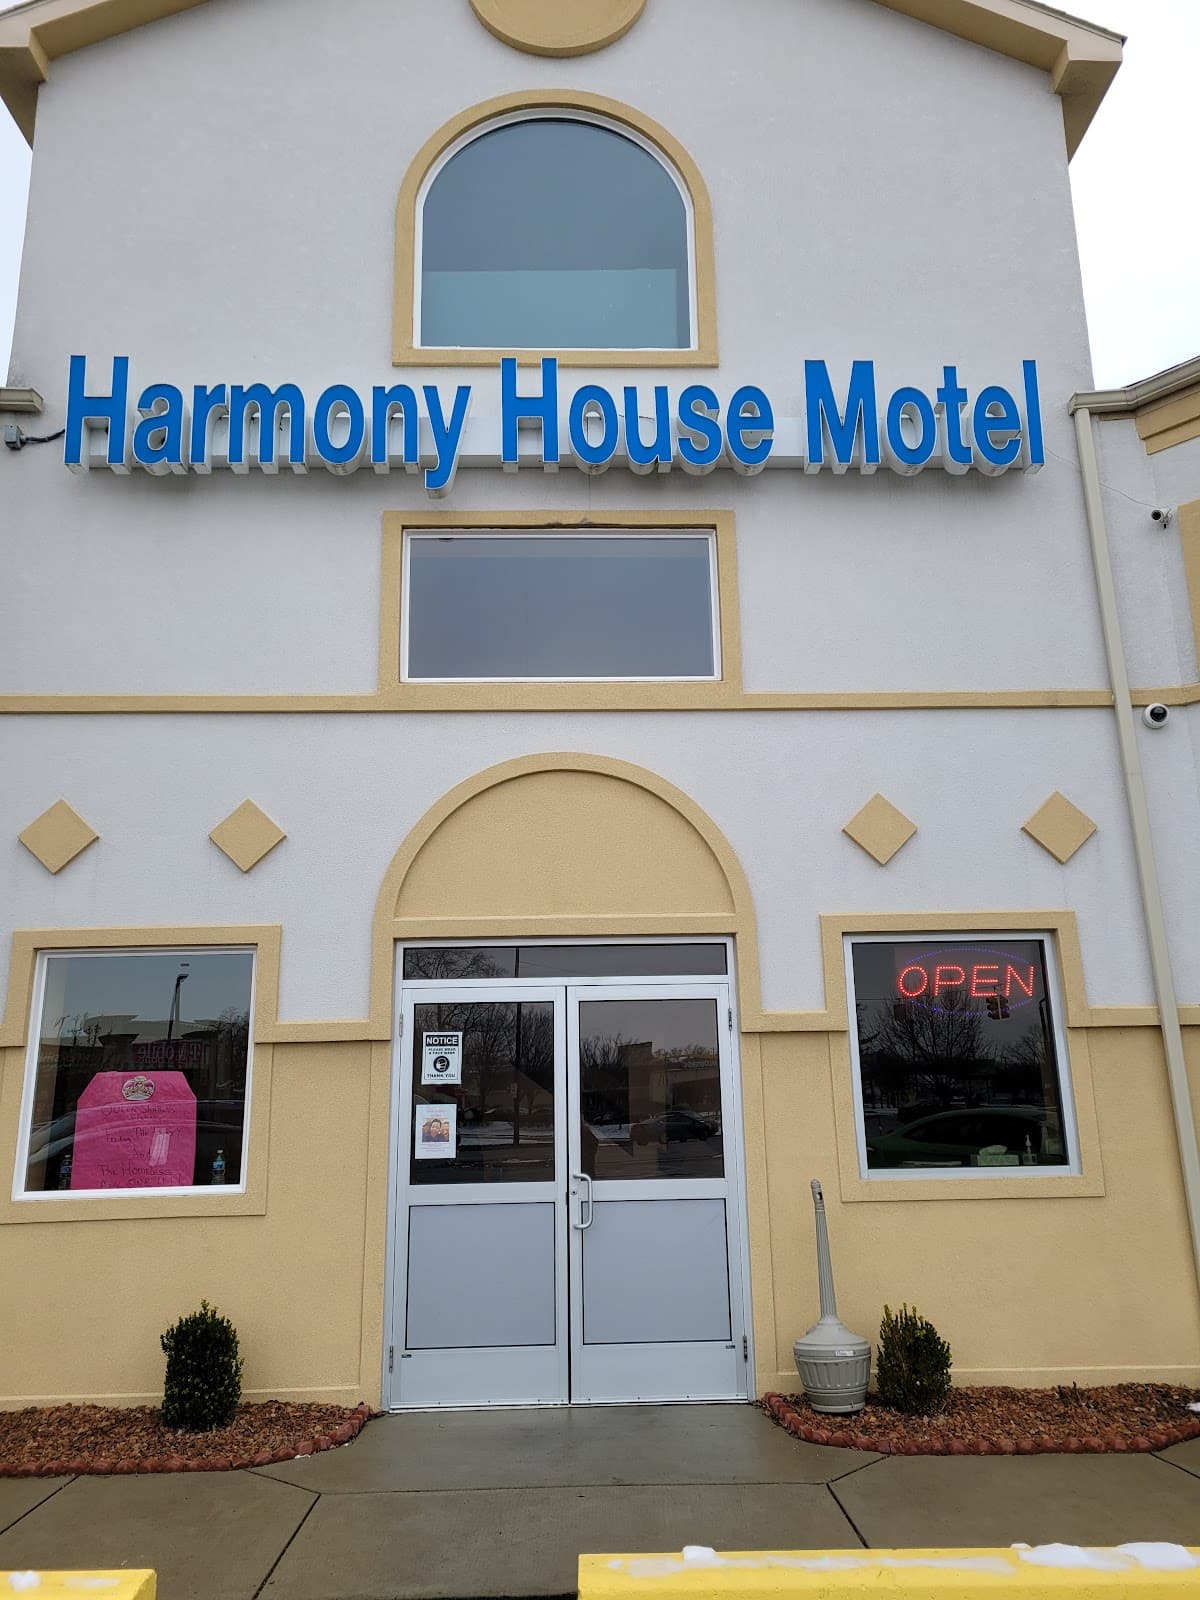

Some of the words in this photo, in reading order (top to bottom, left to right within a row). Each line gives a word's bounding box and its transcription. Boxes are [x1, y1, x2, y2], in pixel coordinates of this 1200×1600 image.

[64, 354, 472, 490] Harmony
[501, 357, 775, 466] House
[804, 359, 1045, 466] Motel
[897, 965, 1036, 998] OPEN
[426, 1036, 458, 1045] NOTICE
